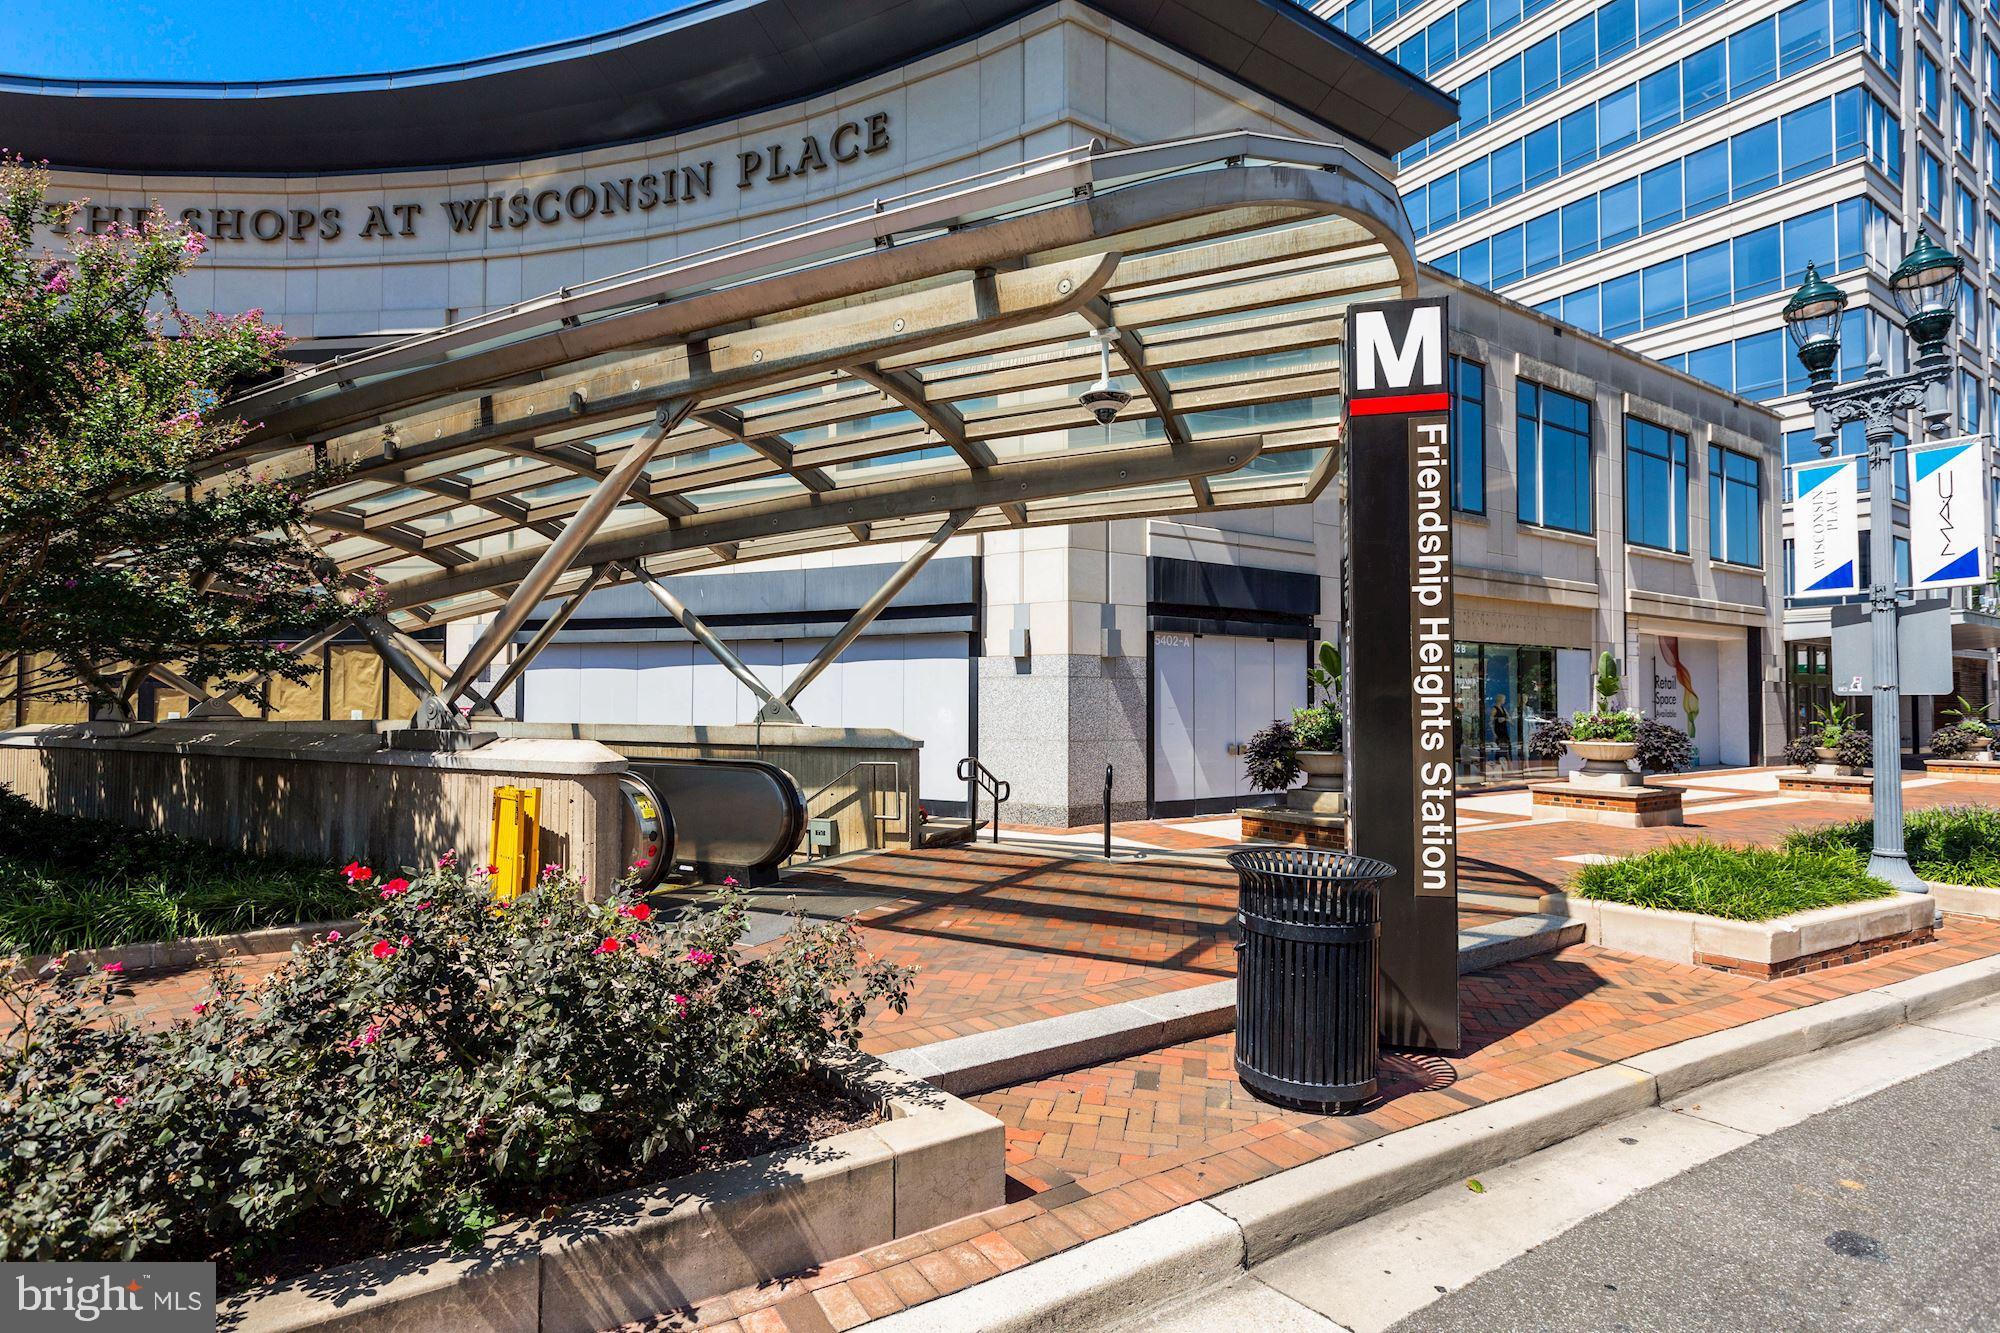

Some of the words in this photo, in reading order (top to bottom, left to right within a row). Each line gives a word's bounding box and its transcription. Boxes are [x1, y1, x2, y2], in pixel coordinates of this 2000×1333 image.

[180, 207, 341, 240] SHOPS
[359, 203, 422, 237] AT
[441, 161, 713, 233] WISCONSIN
[736, 112, 890, 189] PLACE
[1356, 306, 1442, 390] M
[1412, 424, 1449, 606] Friendship
[1812, 490, 1825, 570] WISCONSIN
[1826, 490, 1839, 533] PLACE
[1154, 634, 1190, 648] 5402-A
[1655, 674, 1677, 690] Retail
[1413, 617, 1451, 751] Heights
[1655, 691, 1677, 708] Space
[1421, 762, 1452, 889] Station
